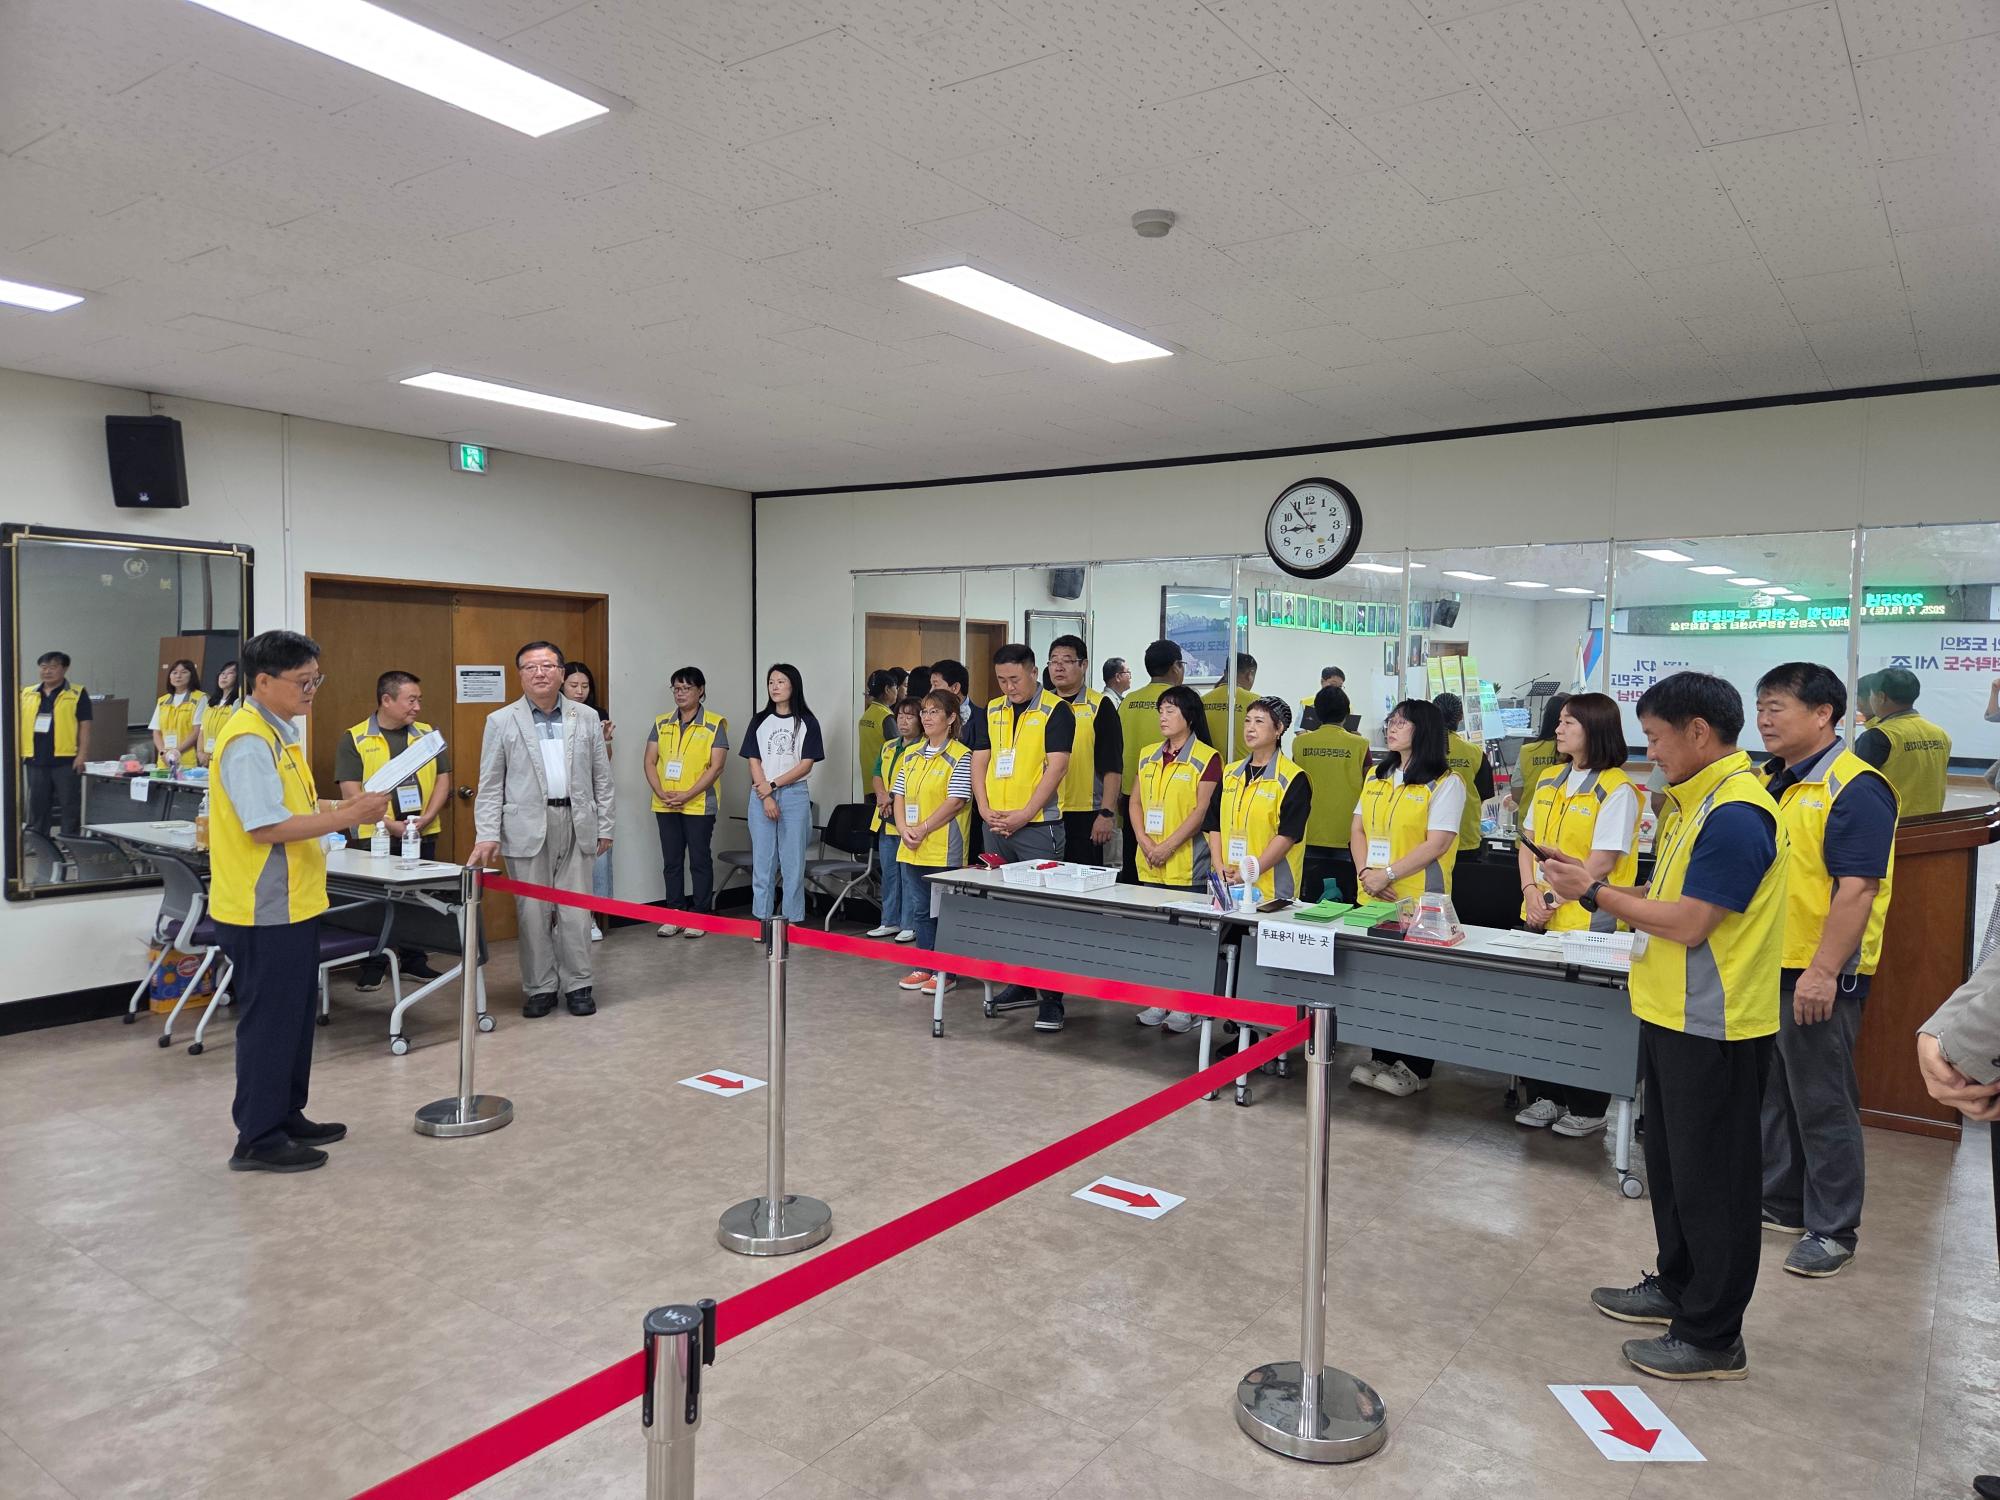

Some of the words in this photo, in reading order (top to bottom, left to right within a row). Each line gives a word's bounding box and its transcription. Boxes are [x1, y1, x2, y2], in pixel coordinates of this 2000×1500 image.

[1305, 495, 1315, 505] 12
[1321, 498, 1326, 507] 1
[1284, 512, 1293, 522] 10
[1328, 507, 1337, 517] 2
[1280, 525, 1287, 534] 9
[1332, 520, 1340, 529] 3
[1283, 537, 1291, 546] 8
[1327, 533, 1335, 543] 4
[1294, 546, 1301, 556] 7
[1305, 549, 1313, 558] 6
[1318, 544, 1326, 554] 5
[1261, 928, 1295, 943] 투표용지
[1298, 933, 1316, 946] 받는
[1320, 936, 1330, 948] 곳
